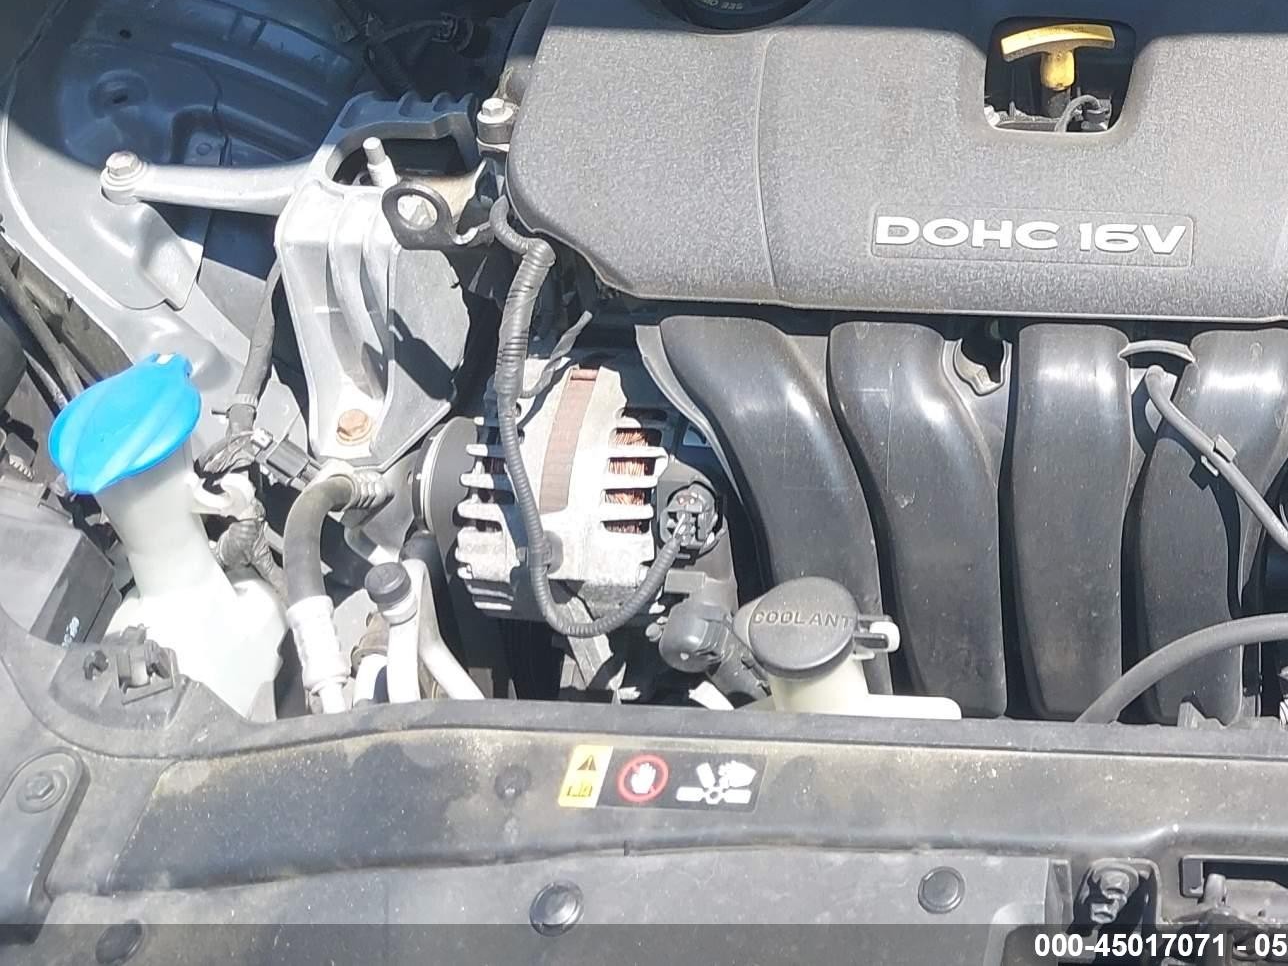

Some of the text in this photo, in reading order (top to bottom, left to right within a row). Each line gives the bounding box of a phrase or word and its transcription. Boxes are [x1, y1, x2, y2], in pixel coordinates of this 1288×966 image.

[875, 216, 1187, 255] DOHC 16V
[752, 609, 853, 630] COOLANT
